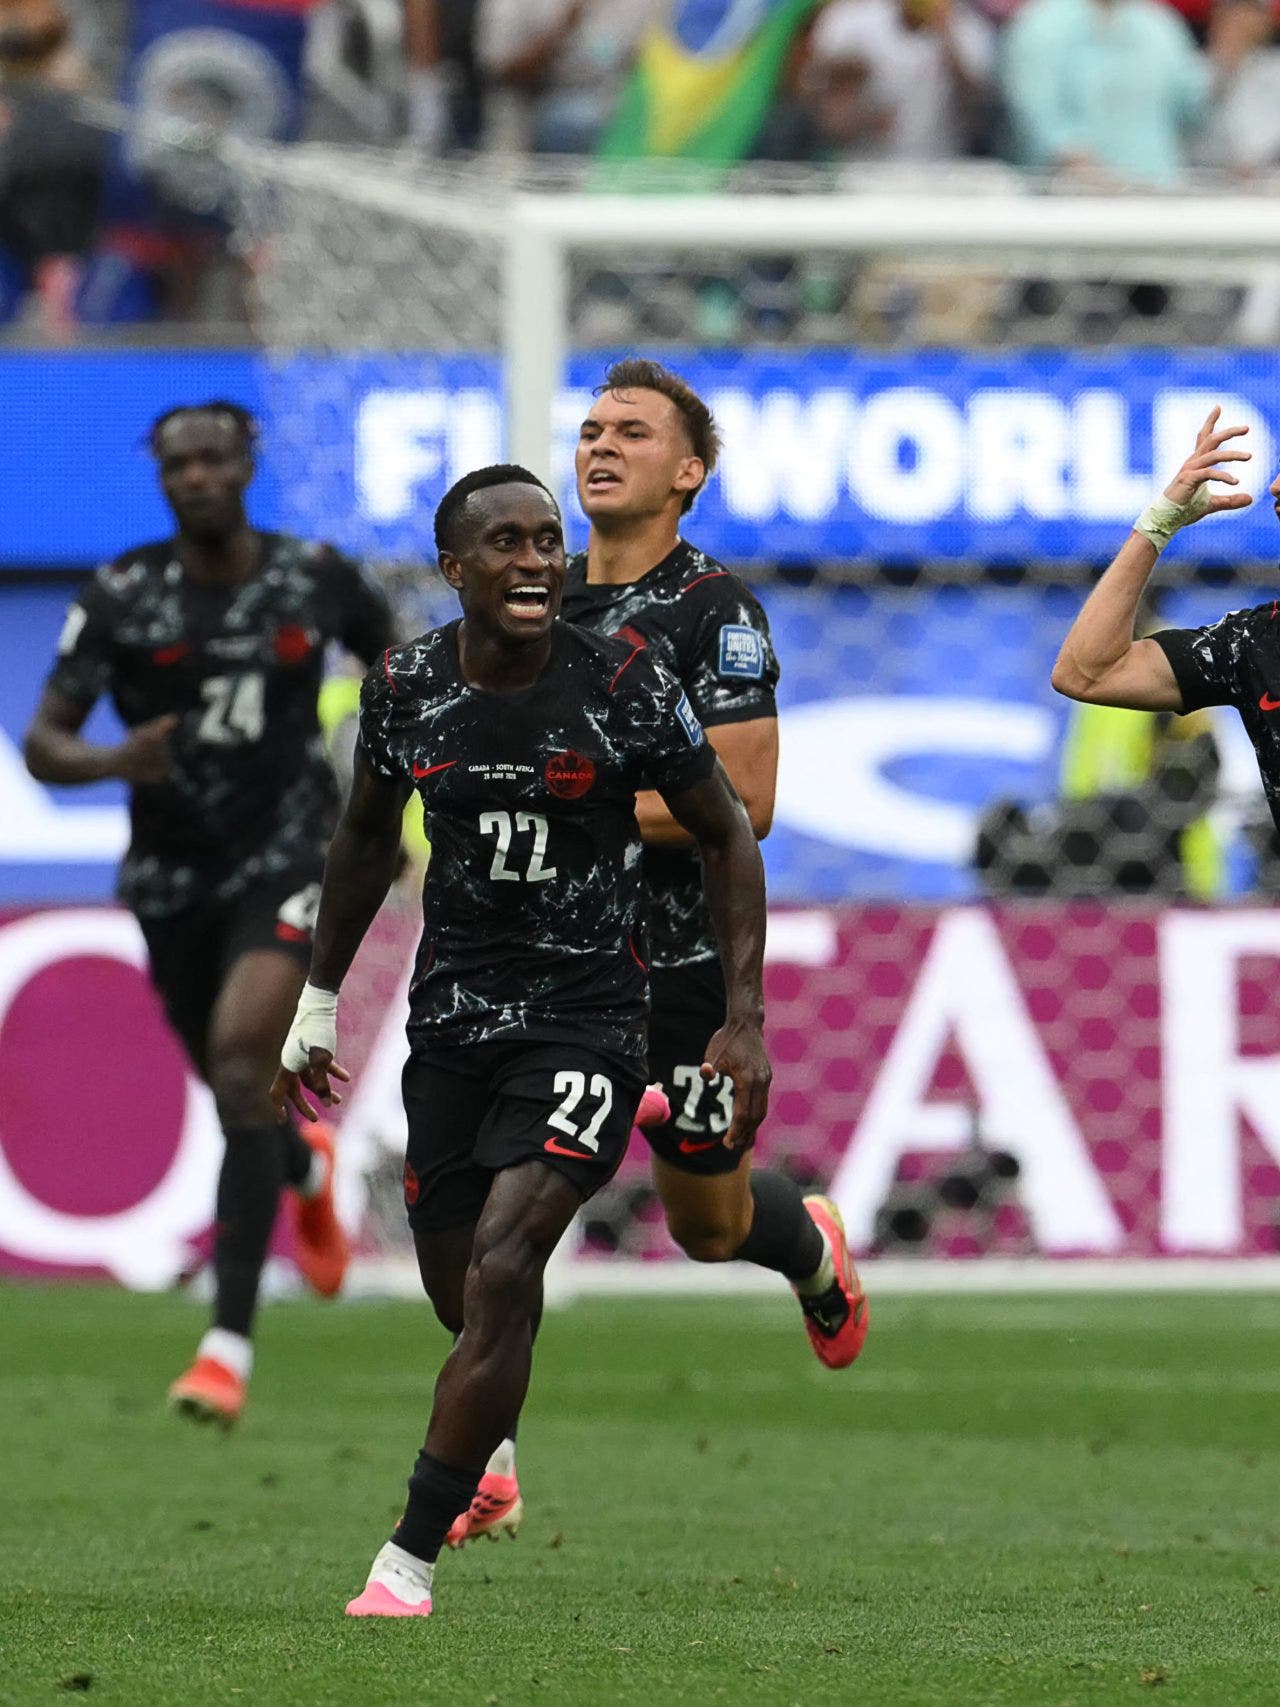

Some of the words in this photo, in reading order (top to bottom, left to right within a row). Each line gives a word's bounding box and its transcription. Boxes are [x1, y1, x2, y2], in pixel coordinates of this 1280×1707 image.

[356, 386, 610, 522] FI
[710, 386, 1270, 525] WORLD
[199, 673, 266, 742] 24
[546, 771, 593, 780] CANADA
[479, 811, 557, 882] 22
[547, 1070, 613, 1154] 22
[673, 1064, 736, 1134] 23
